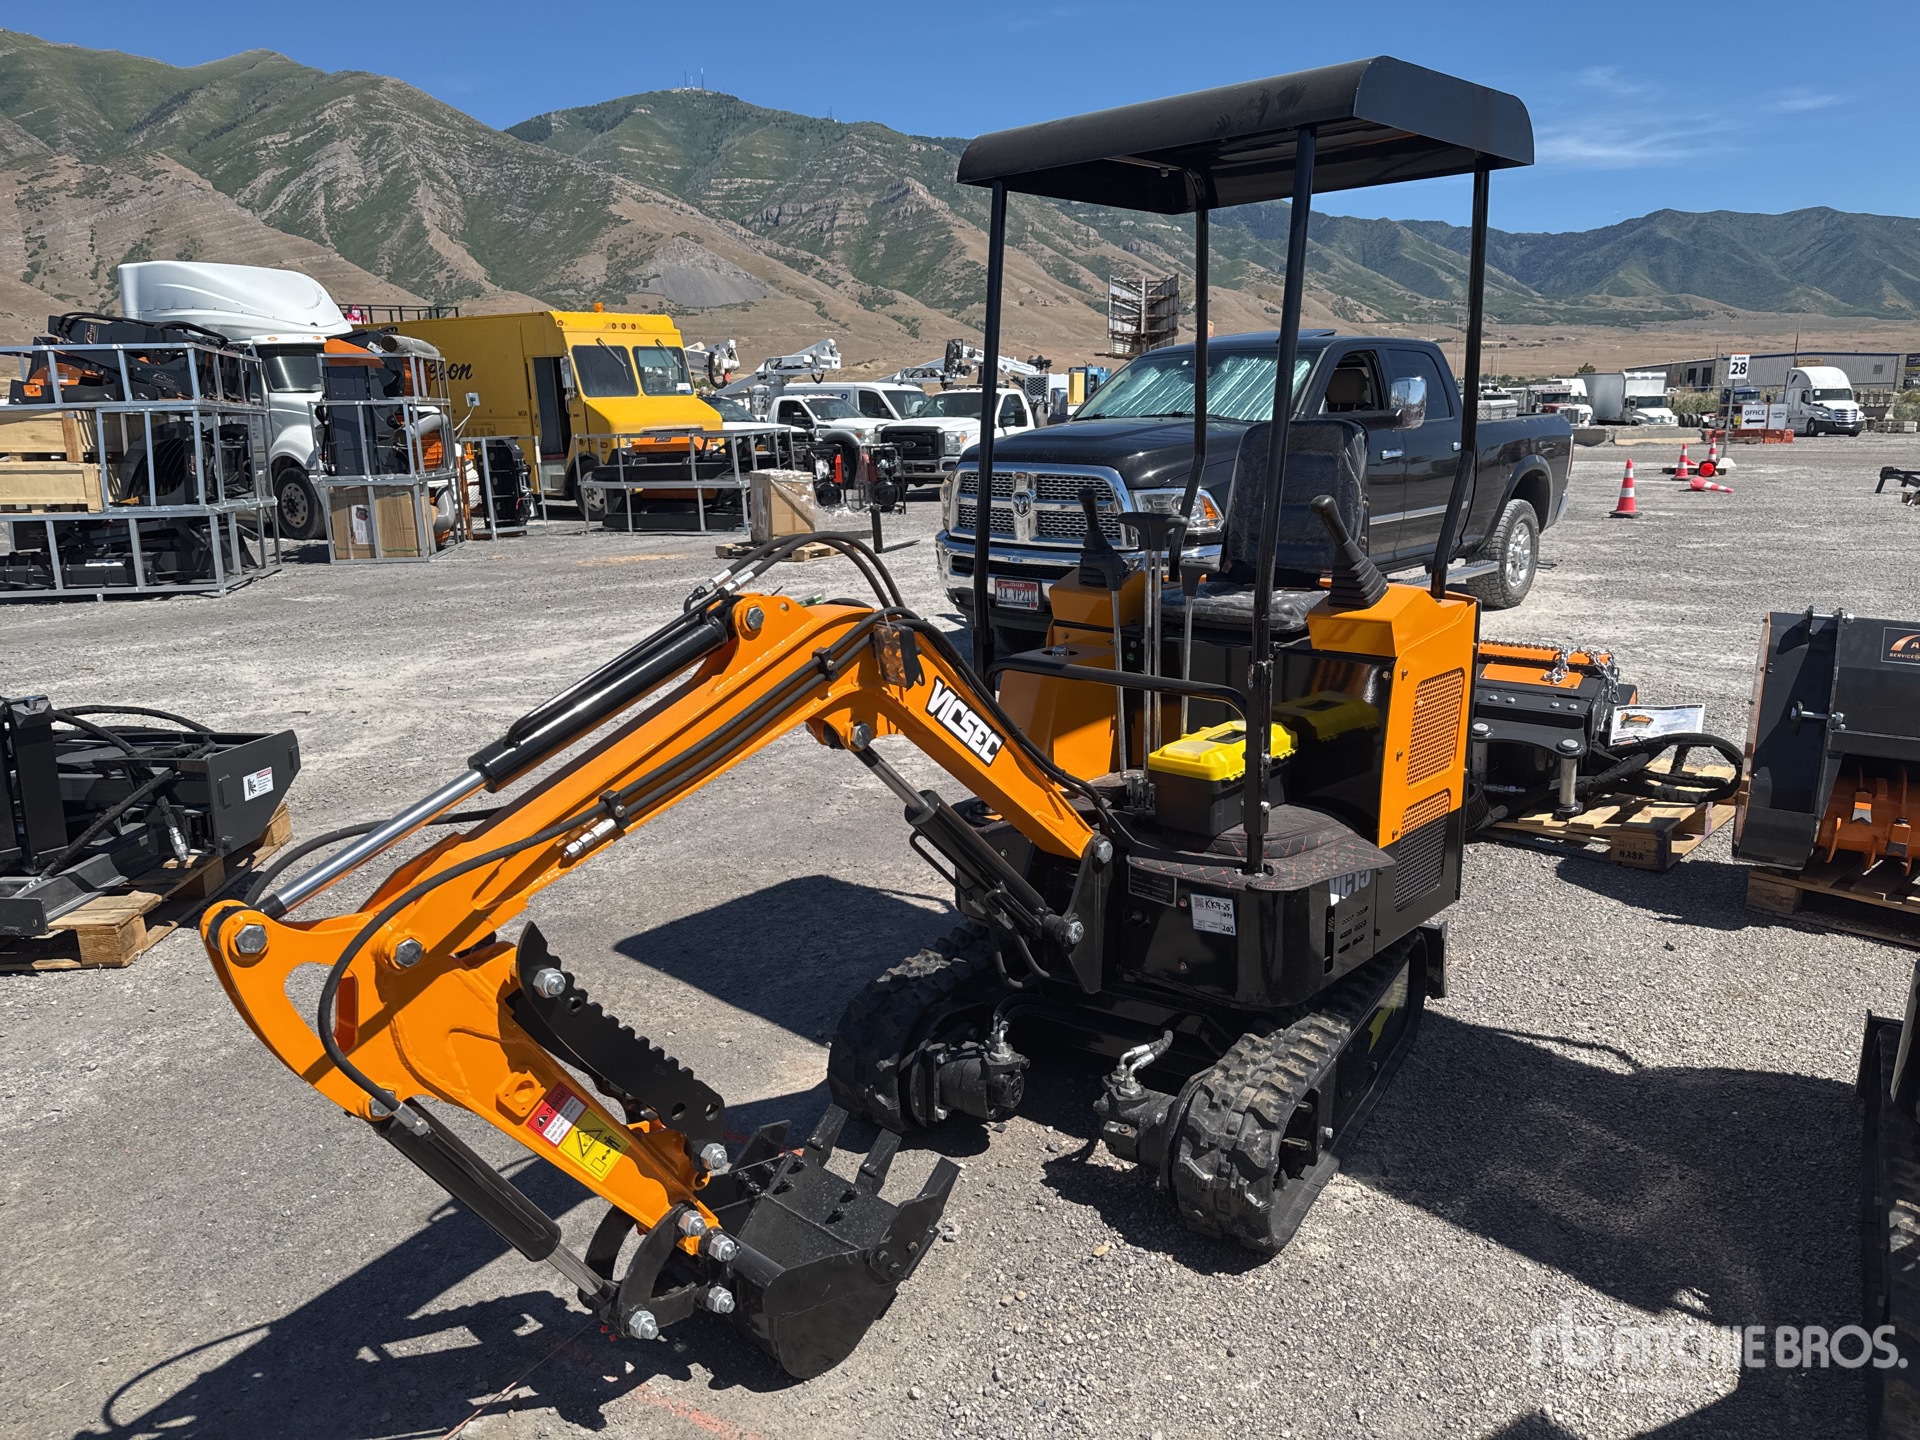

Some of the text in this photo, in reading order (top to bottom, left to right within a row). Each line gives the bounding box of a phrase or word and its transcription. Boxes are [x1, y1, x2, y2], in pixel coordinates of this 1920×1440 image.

[1730, 361, 1748, 375] 28
[926, 676, 1005, 766] VICSEC
[1619, 850, 1644, 861] NASA
[545, 1089, 567, 1115] DANGER
